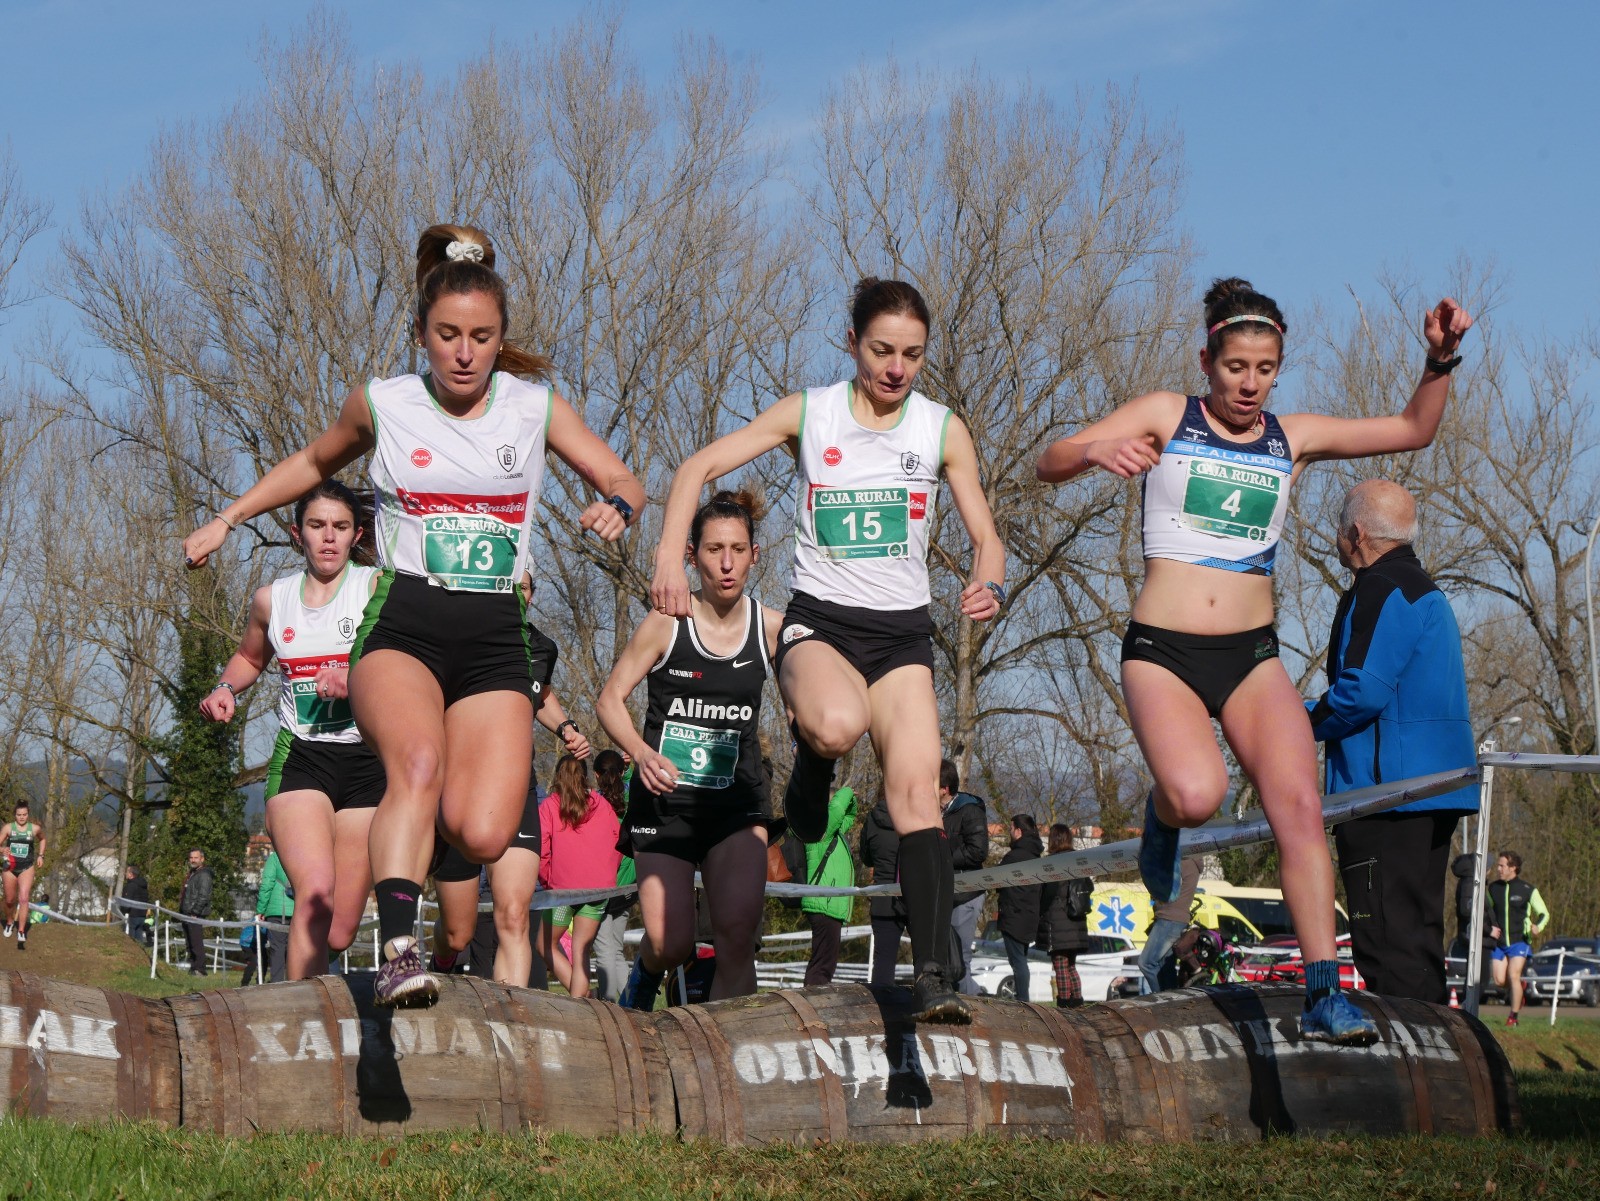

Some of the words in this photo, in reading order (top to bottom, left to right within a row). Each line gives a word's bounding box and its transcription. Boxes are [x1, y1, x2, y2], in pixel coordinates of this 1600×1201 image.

[1231, 469, 1275, 488] RURAL
[820, 492, 852, 504] CAJA
[855, 490, 902, 503] RURAL
[1221, 489, 1242, 518] 4
[432, 519, 468, 530] CAJA
[470, 519, 515, 538] RURAL
[842, 512, 882, 540] 15
[457, 540, 494, 571] 13
[322, 696, 336, 718] 7
[667, 697, 753, 720] Alimco
[670, 726, 696, 739] CAJA
[698, 731, 733, 743] RURAL
[690, 747, 707, 770] 9
[733, 1034, 1075, 1088] OINKARIAK
